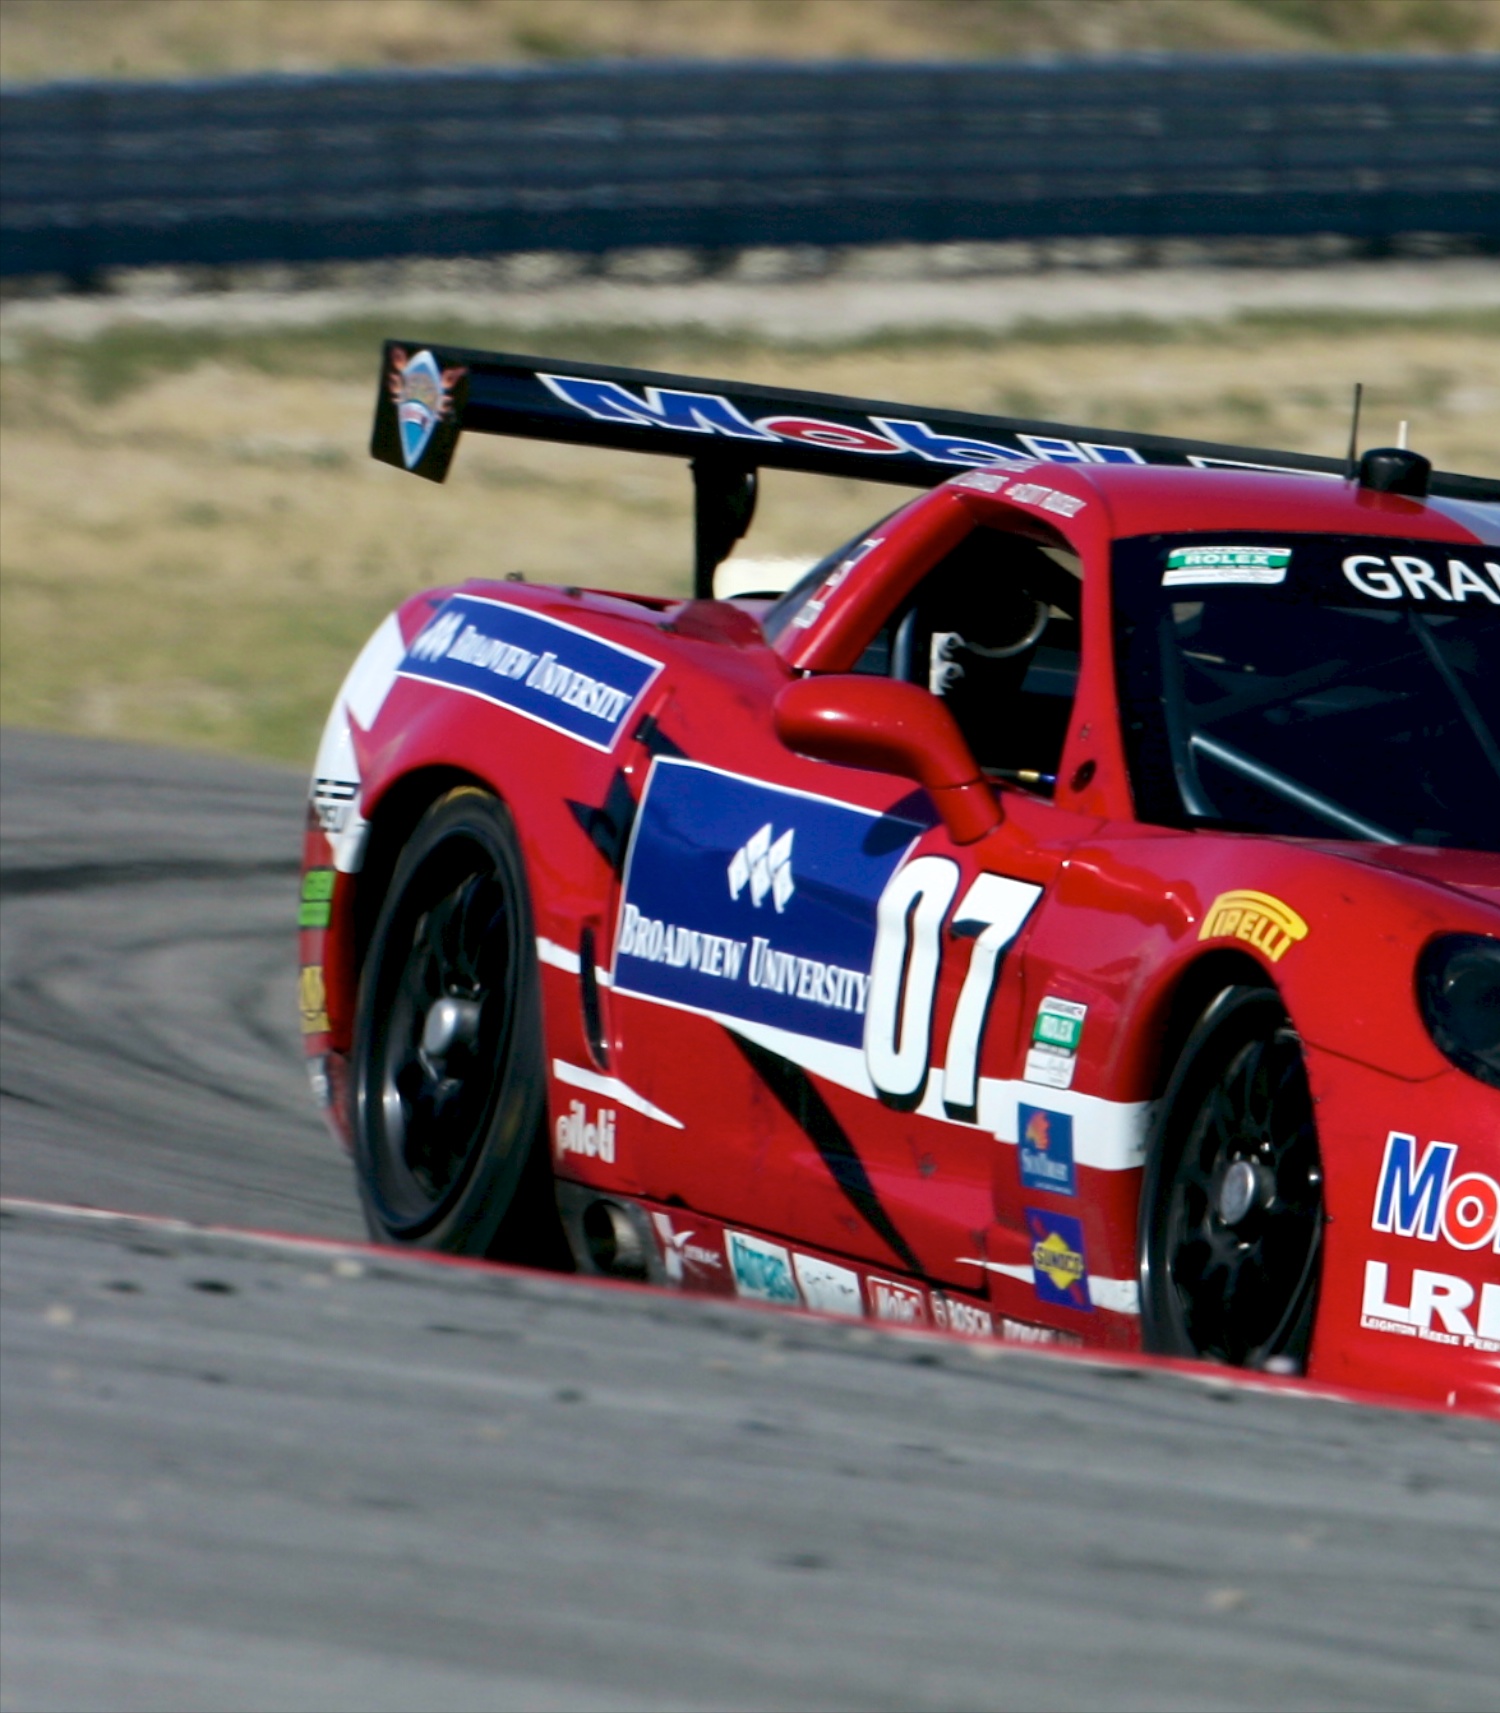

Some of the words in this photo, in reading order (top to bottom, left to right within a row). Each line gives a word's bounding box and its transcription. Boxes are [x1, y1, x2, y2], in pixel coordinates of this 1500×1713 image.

[1184, 553, 1269, 566] ROLEX
[618, 903, 748, 981] BROADVIEW
[748, 936, 873, 1014] UNIVERSITY
[1197, 889, 1308, 963] PIRELLI
[863, 855, 1044, 1123] 07
